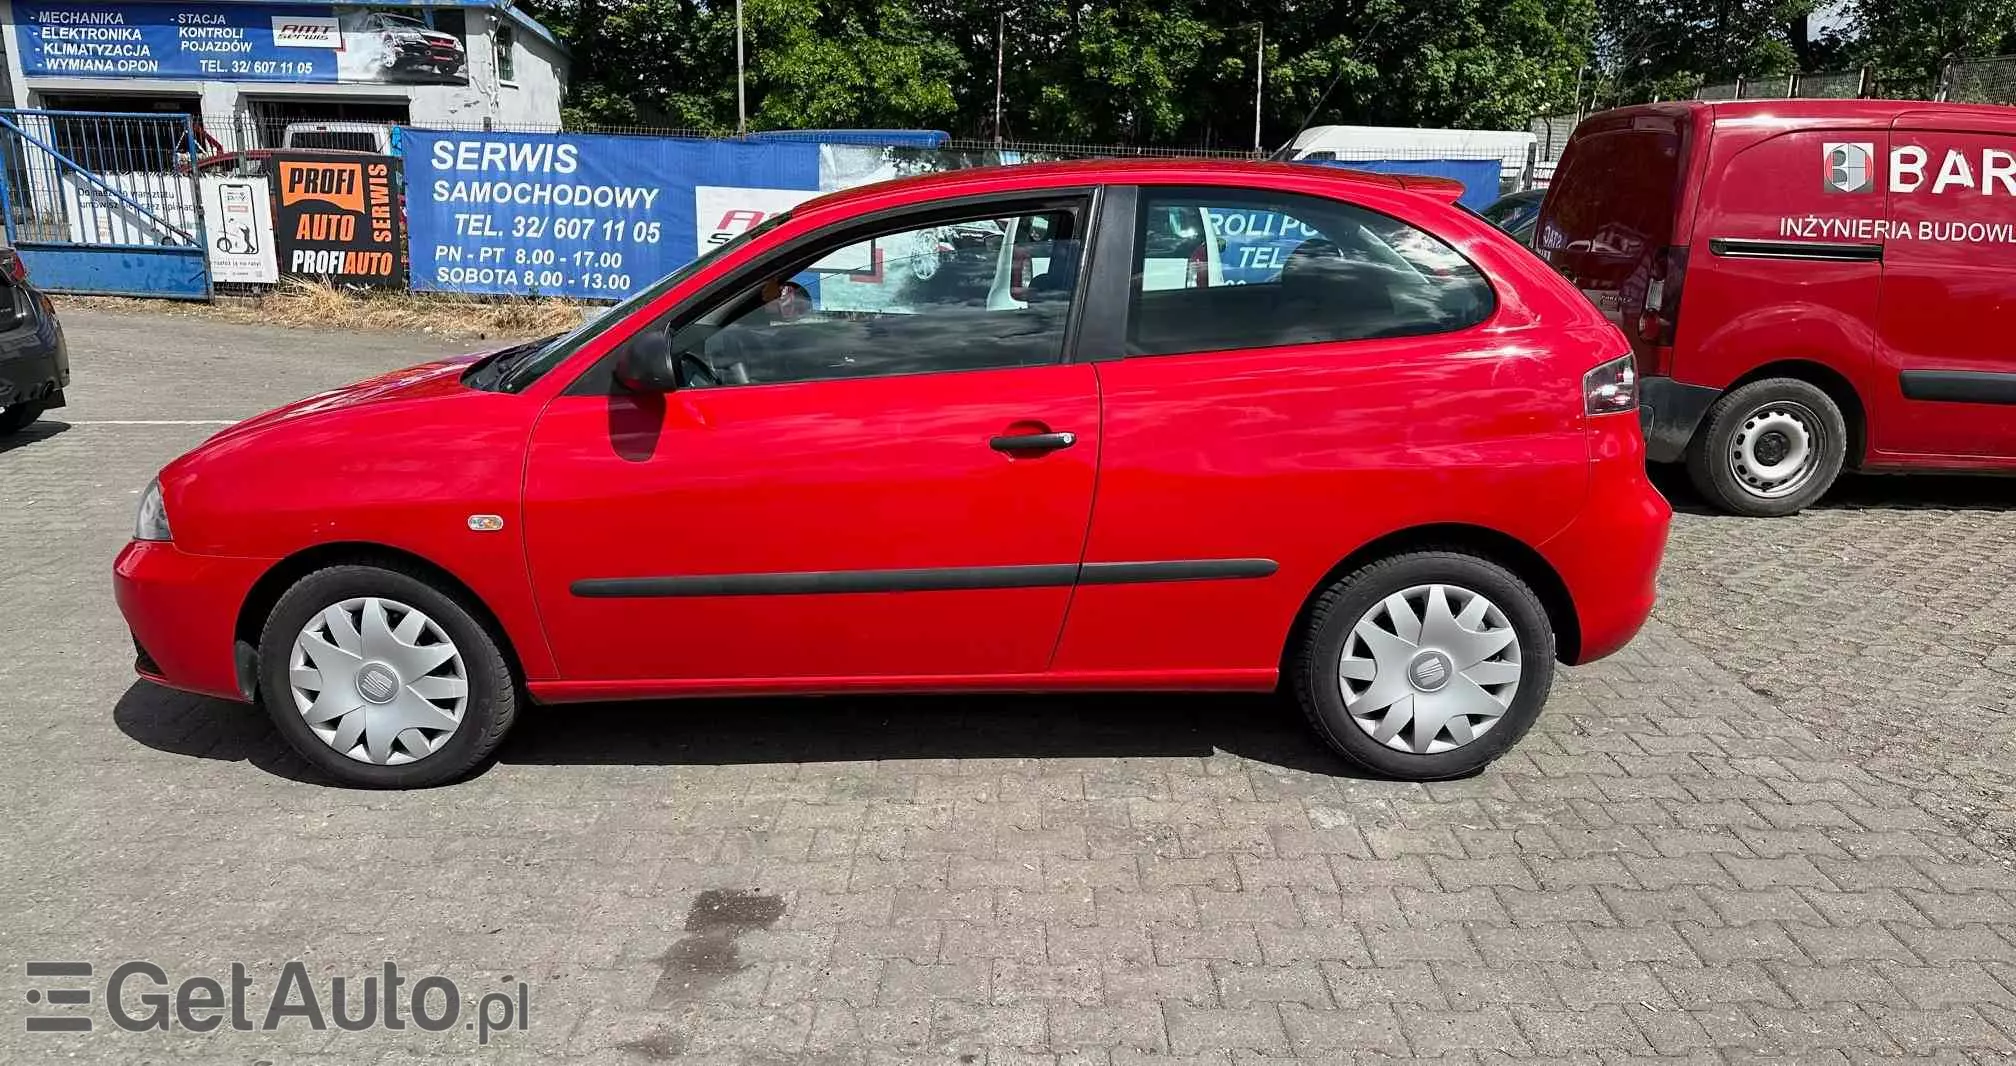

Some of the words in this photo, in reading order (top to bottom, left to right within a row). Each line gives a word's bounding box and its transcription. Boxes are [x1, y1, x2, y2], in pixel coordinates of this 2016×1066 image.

[38, 11, 124, 24] MECHANIKA
[178, 13, 226, 25] STACJA
[41, 27, 142, 41] ELEKTRONIKA
[179, 27, 243, 39] KONTROLI
[44, 42, 151, 57] KLIMATYZACJA
[181, 39, 253, 52] POJAZDÓW
[46, 58, 117, 71] WYMIANA
[117, 61, 159, 72] OPON
[200, 59, 228, 73] TEL.
[231, 60, 251, 74] 32/
[254, 61, 275, 74] 607
[280, 62, 292, 74] 11
[297, 62, 313, 74] 05
[431, 140, 579, 174] SERWIS
[288, 167, 355, 195] PROFI
[368, 164, 392, 242] SERWIS
[432, 179, 660, 209] SAMOCHODOWY
[296, 213, 356, 241] AUTO
[455, 213, 504, 237] TEL.
[512, 216, 549, 238] 32/
[553, 217, 595, 240] 607
[603, 219, 625, 242] 11
[633, 221, 661, 244] 05
[1208, 213, 1275, 237] ROLI
[1779, 214, 1913, 240] INŻYNIERIA
[1918, 221, 2016, 244] BUDOWL
[291, 249, 393, 276] PROFIAUTO
[435, 245, 463, 262] PN
[479, 247, 505, 263] PT
[515, 249, 555, 266] 8.00
[573, 251, 622, 268] 17.00
[437, 266, 518, 286] SOBOTA
[523, 270, 563, 287] 8.00
[582, 273, 631, 290] 13.00
